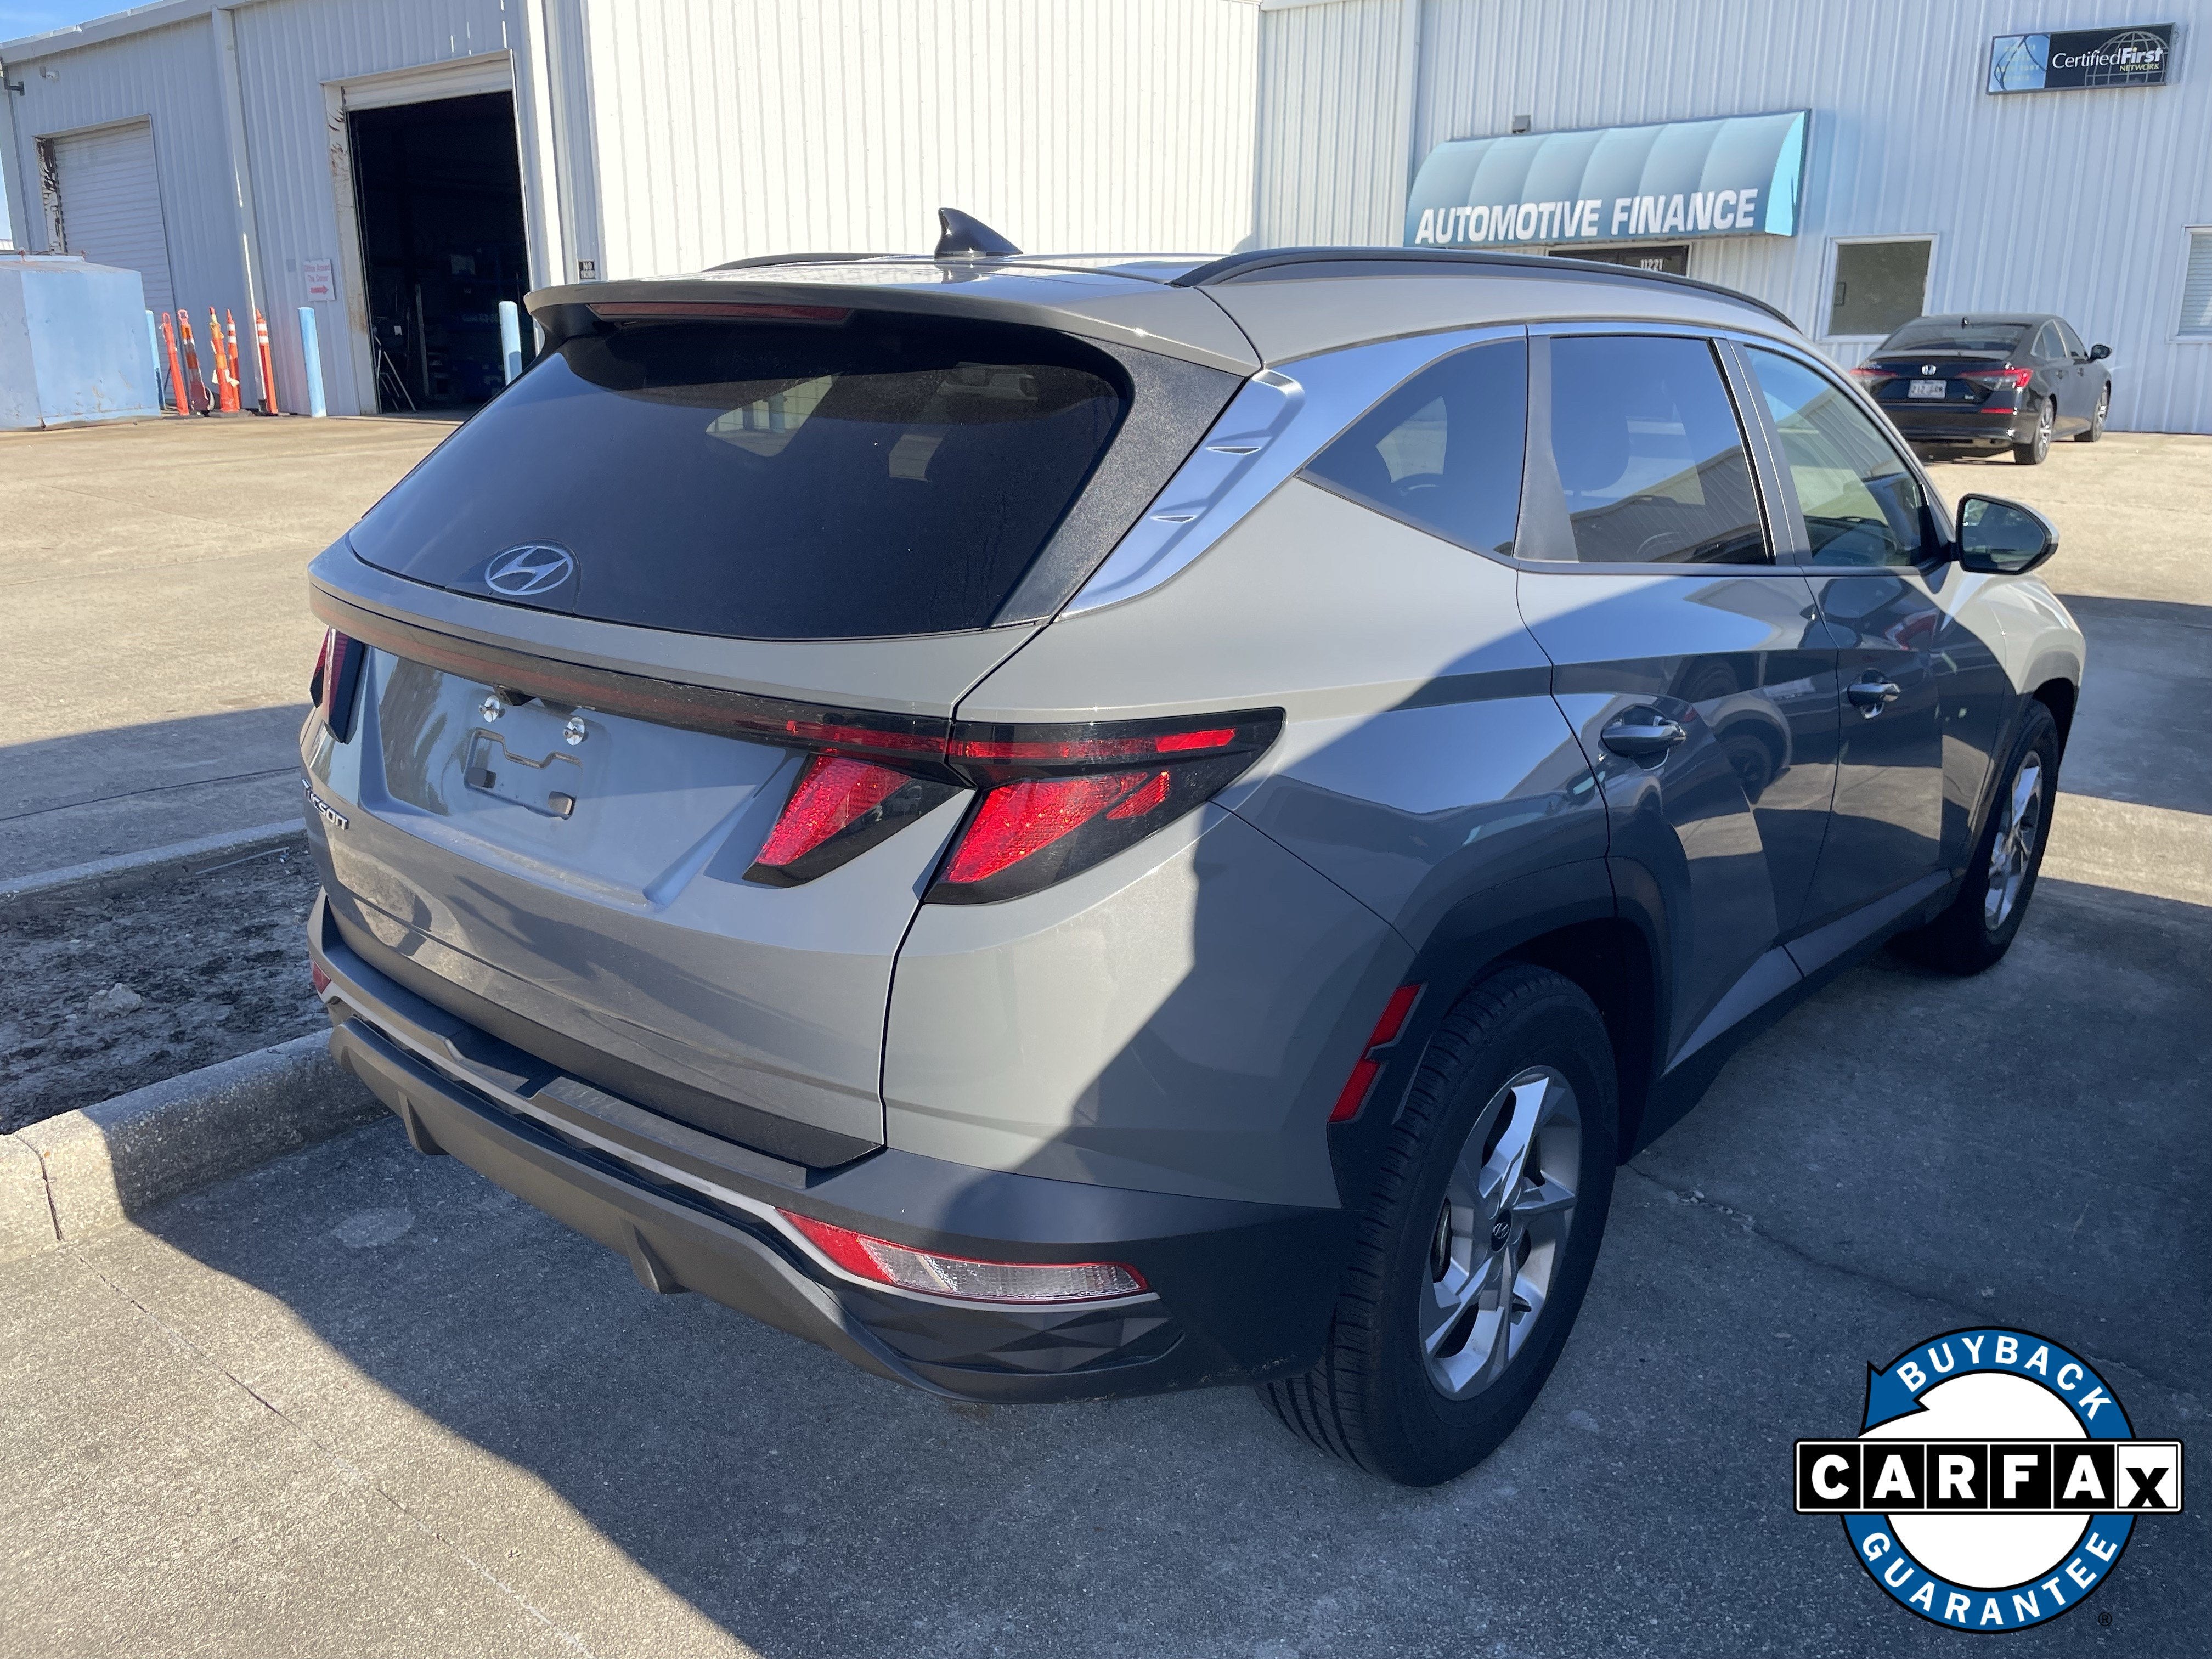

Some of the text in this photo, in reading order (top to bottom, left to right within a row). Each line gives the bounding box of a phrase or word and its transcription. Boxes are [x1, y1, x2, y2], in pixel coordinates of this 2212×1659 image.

[2119, 63, 2160, 72] NETWORK
[1414, 188, 1758, 245] AUTOMOTIVE FINANCE
[583, 262, 592, 270] NO
